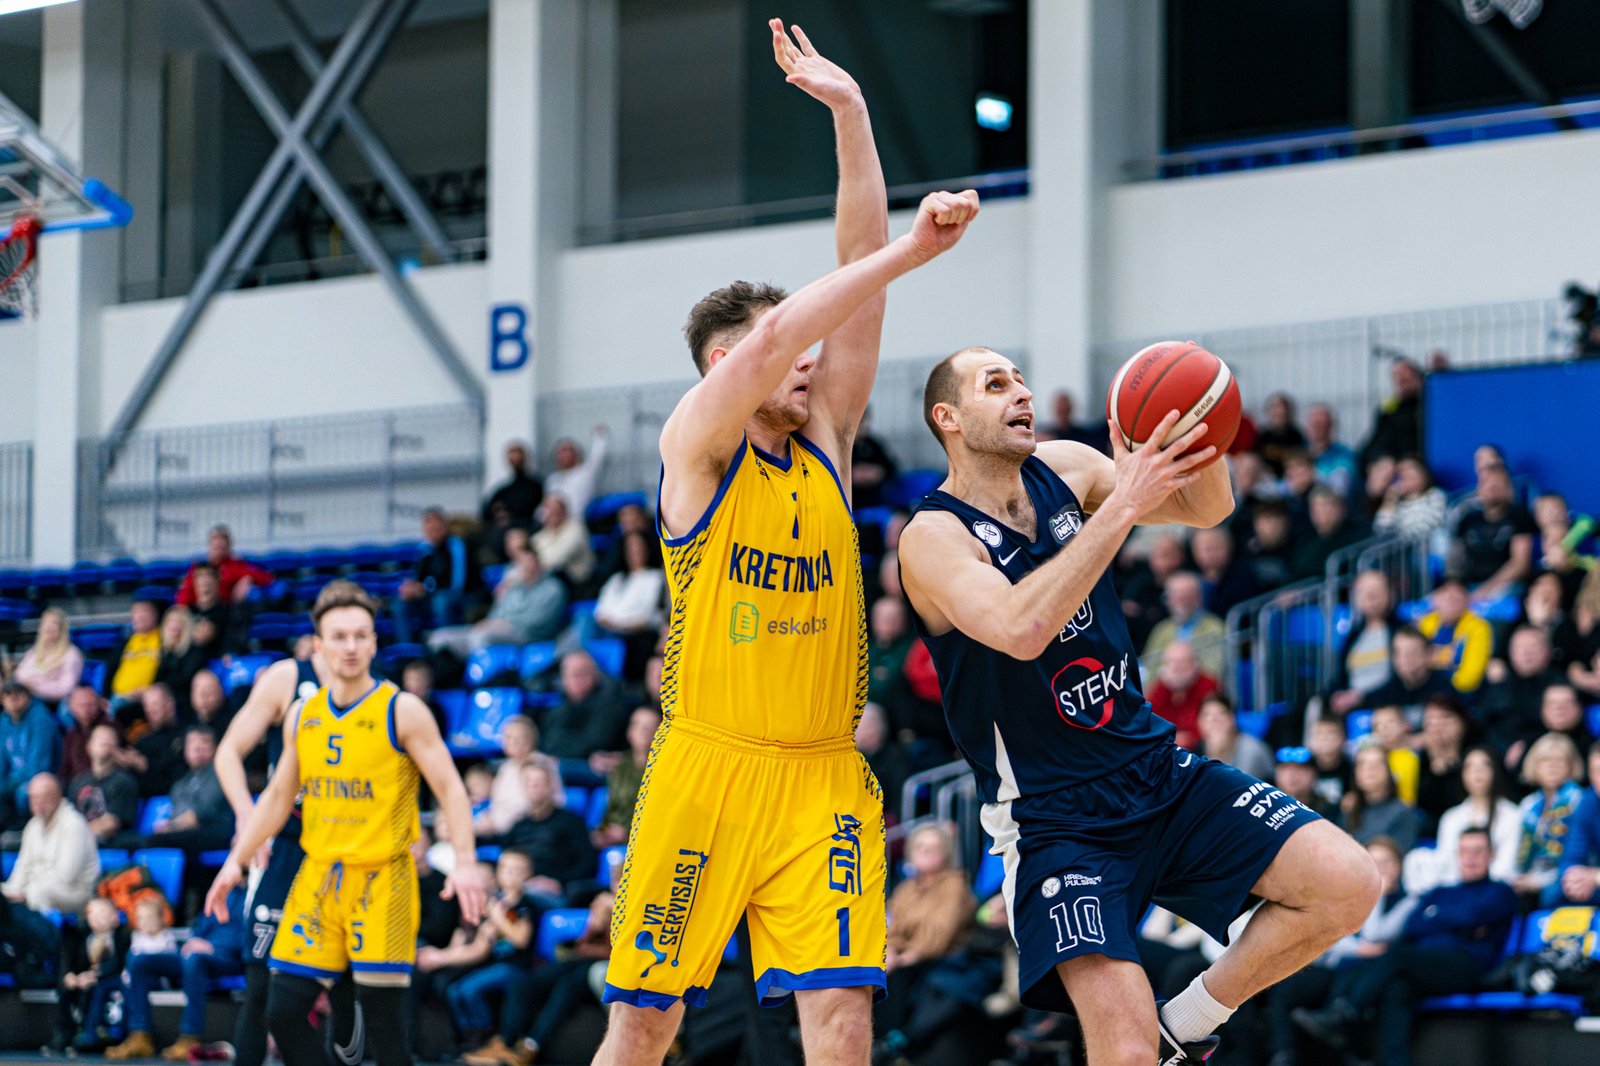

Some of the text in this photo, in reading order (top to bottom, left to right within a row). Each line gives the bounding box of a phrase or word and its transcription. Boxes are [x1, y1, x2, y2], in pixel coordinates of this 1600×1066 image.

[489, 304, 529, 372] B
[1060, 595, 1093, 643] 0
[326, 734, 344, 765] 5
[1265, 803, 1299, 828] LIREMA
[643, 903, 666, 926] VR
[659, 863, 697, 946] SERVISAS
[1050, 896, 1105, 953] 10
[252, 922, 276, 959] 7
[351, 920, 363, 952] 5
[836, 907, 850, 957] 1
